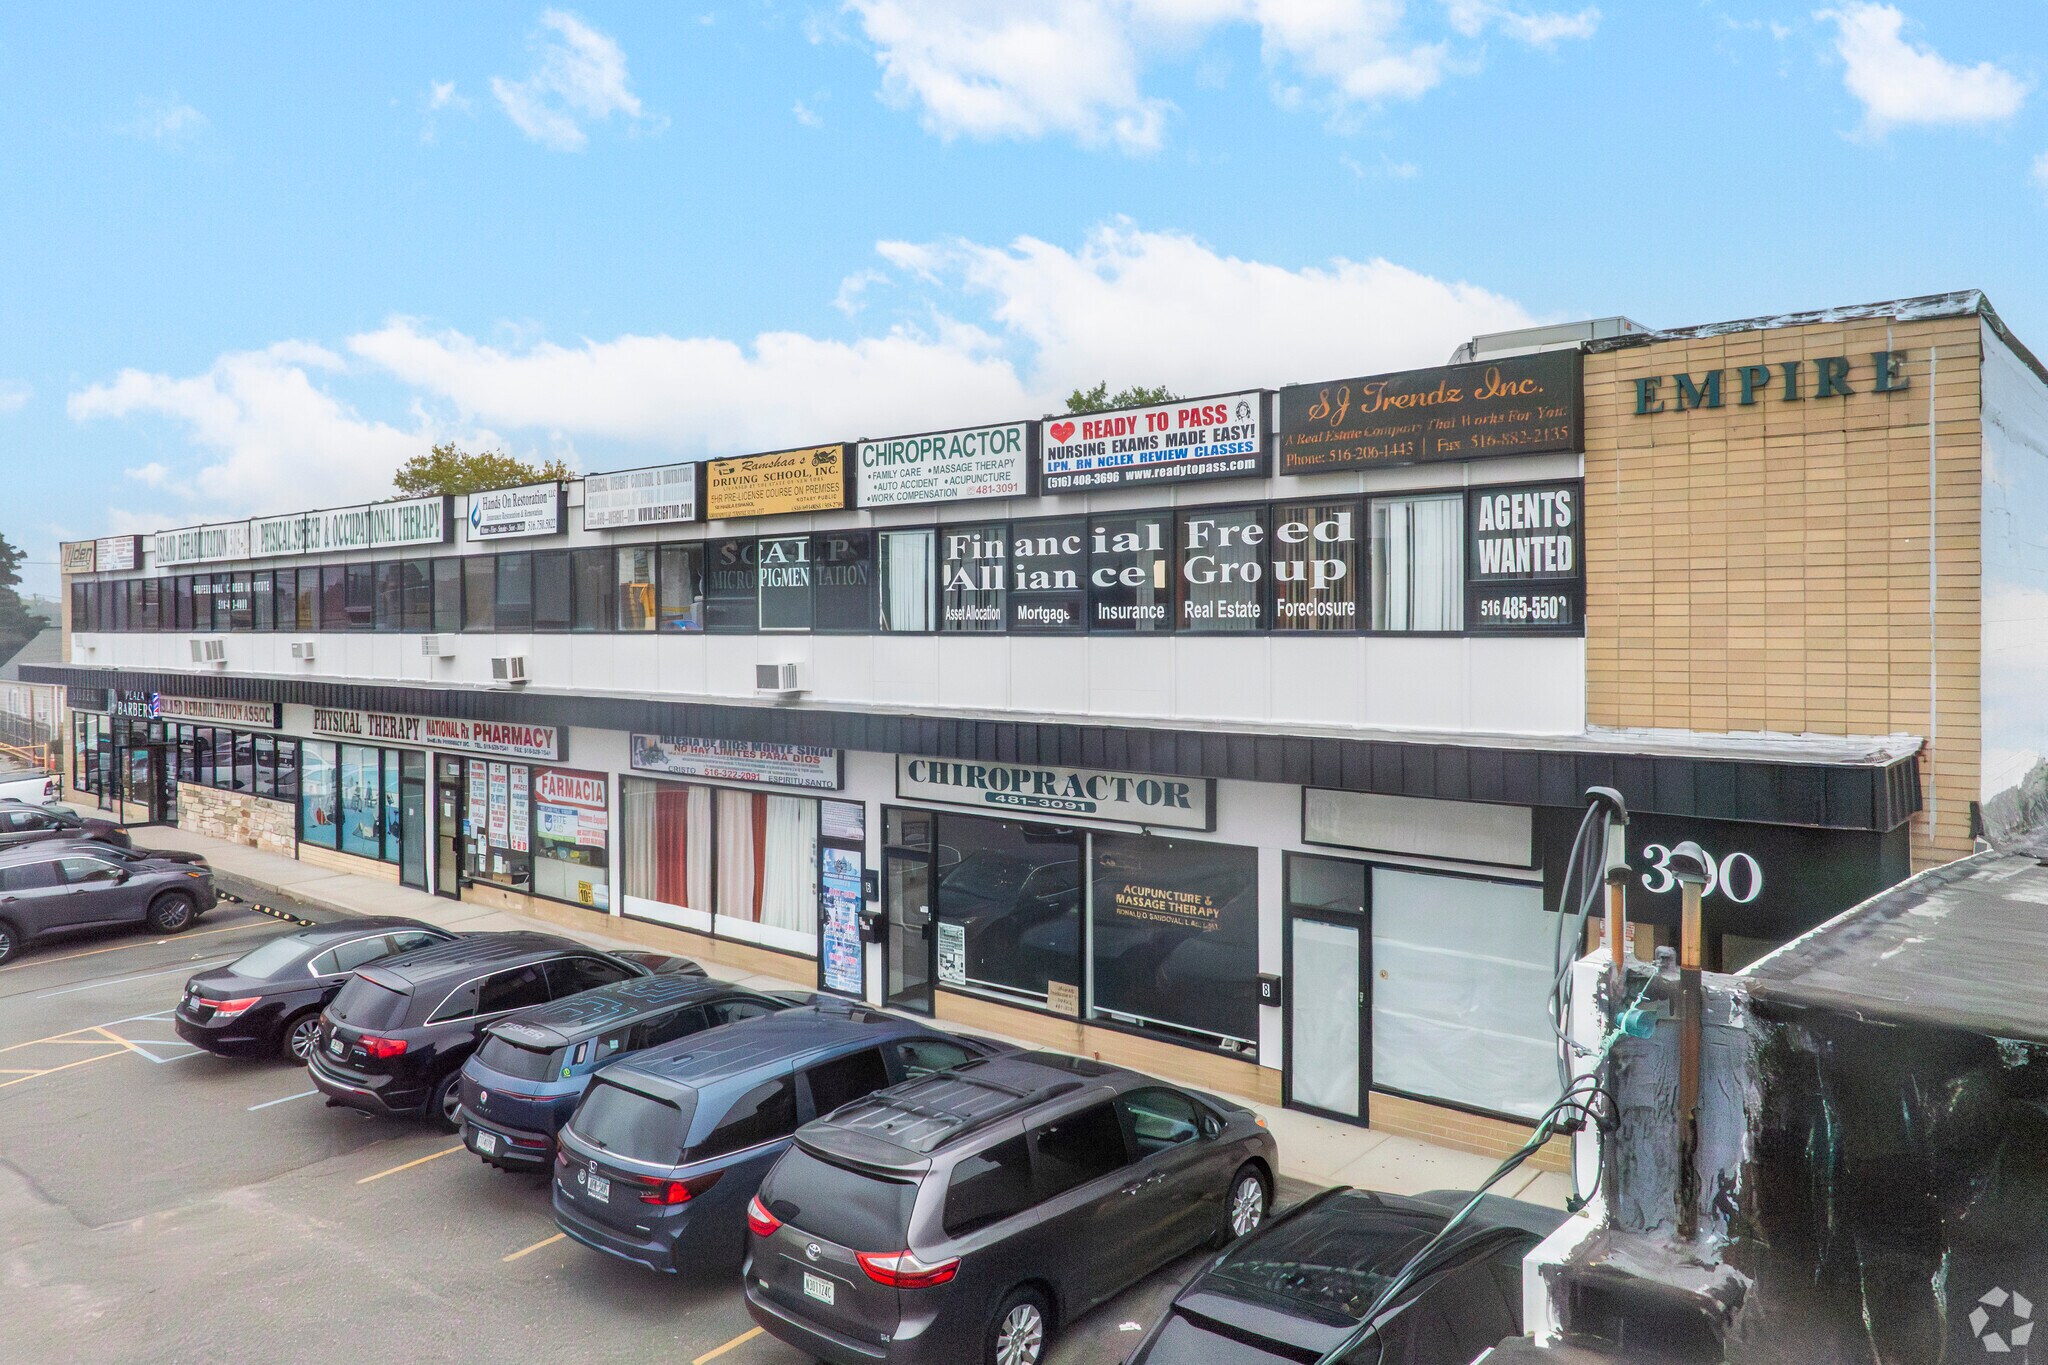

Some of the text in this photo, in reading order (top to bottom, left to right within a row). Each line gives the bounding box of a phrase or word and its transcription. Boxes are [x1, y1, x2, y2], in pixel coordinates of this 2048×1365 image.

[1633, 350, 1910, 416] EMPIRE
[1308, 366, 1544, 428] SJ Trendz Inc.
[1082, 403, 1228, 440] READY TO PASS
[1508, 408, 1531, 422] For
[862, 427, 1022, 468] CHIROPRACTOR
[1048, 423, 1256, 461] NURSING EXAMS MADE EASY!
[1076, 457, 1093, 469] RN
[1097, 452, 1135, 468] NCLEX
[1139, 447, 1189, 463] REVIEW
[1194, 441, 1254, 458] CLASSES
[1286, 452, 1325, 467] Phone:
[713, 465, 839, 488] DRIVING SCHOOL, INC.
[872, 458, 1016, 480] FAMILY CARE MASSAGE THERAPY
[877, 471, 1011, 491] AUTO ACCIDENT ACUPUNCTURE
[1047, 457, 1256, 489] (516) 408-3696 www.readytopass.com
[724, 489, 764, 501] PRE-LICENSE
[765, 486, 792, 498] COURSE
[794, 484, 804, 495] ON
[805, 482, 840, 494] PREMISES
[871, 482, 1018, 502] WORK COMPENSATION 481-3091
[398, 503, 440, 541] THERAPY
[1478, 490, 1572, 531] AGENTS
[1184, 512, 1355, 549] Freed
[1478, 535, 1573, 574] WANTED
[1183, 555, 1348, 590] Group
[945, 604, 964, 620] Asset
[1098, 603, 1165, 620] Insurance
[1184, 601, 1213, 618] Real
[1217, 600, 1261, 618] Estate
[1277, 598, 1356, 617] Foreclosure
[1480, 600, 1501, 616] 516
[117, 701, 153, 718] BARBERS
[244, 706, 272, 724] ASSOC.
[314, 709, 420, 741] PHYSICAL THERAPY
[426, 719, 459, 738] NATIONAL
[473, 723, 553, 748] PHARMACY
[674, 745, 688, 753] NO
[690, 746, 710, 755] HAY
[713, 747, 756, 758] LIMITES
[760, 751, 788, 761] PARA
[792, 755, 821, 764] DIOS
[668, 766, 696, 774] CRISTO
[768, 776, 833, 787] ESPIRITU SANTO
[541, 775, 603, 803] FARMACIA
[907, 759, 1192, 810] CHIROPRACTOR
[995, 794, 1086, 811] 481-3091
[1115, 894, 1220, 918] MASSAGE THERAPY
[1123, 885, 1202, 904] ACUPUNCTURE
